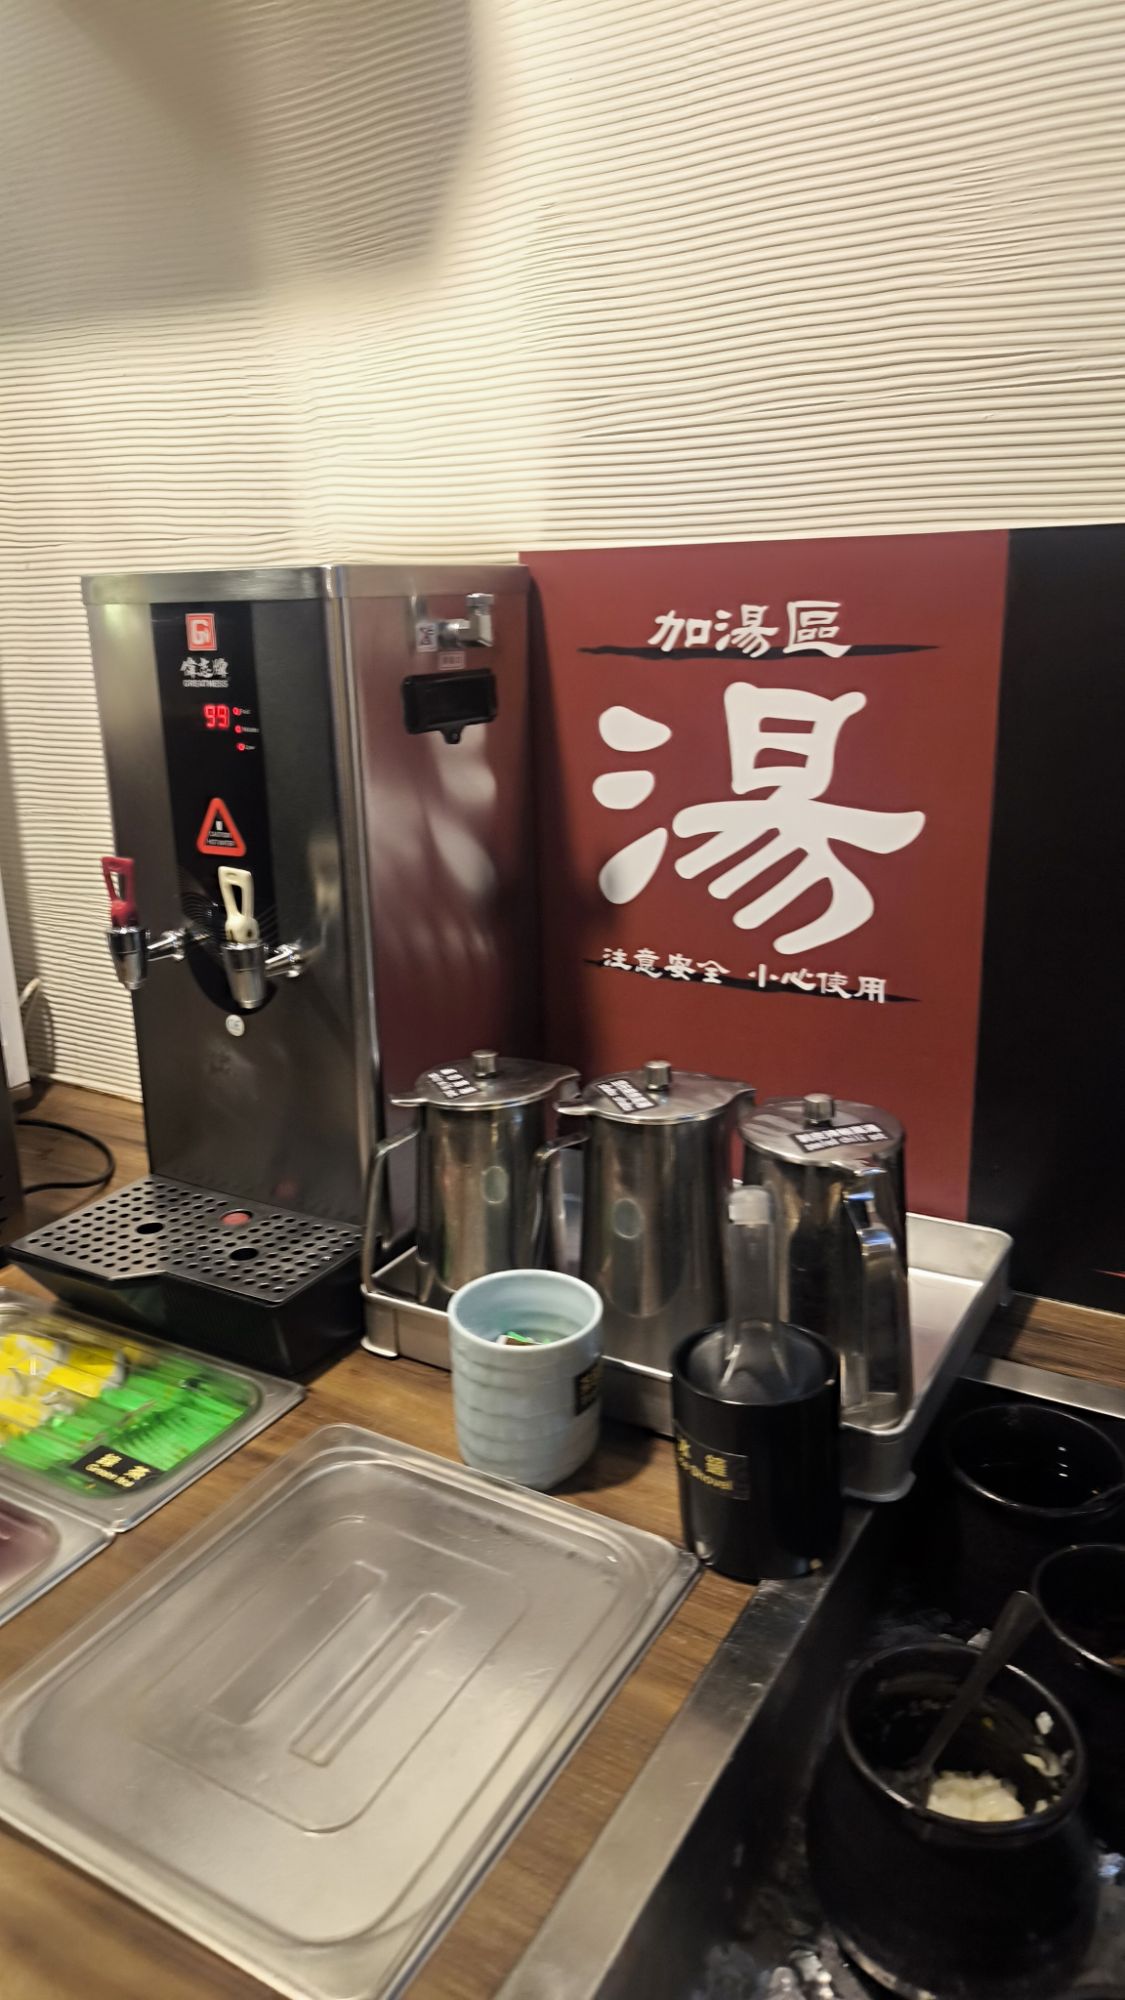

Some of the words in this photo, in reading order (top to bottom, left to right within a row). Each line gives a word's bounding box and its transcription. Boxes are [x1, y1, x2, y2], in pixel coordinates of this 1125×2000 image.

[648, 600, 851, 658] 加湯區
[203, 704, 230, 729] 99
[592, 681, 926, 955] 湯
[602, 948, 730, 985] 注意安全
[748, 963, 887, 1003] 小心使用
